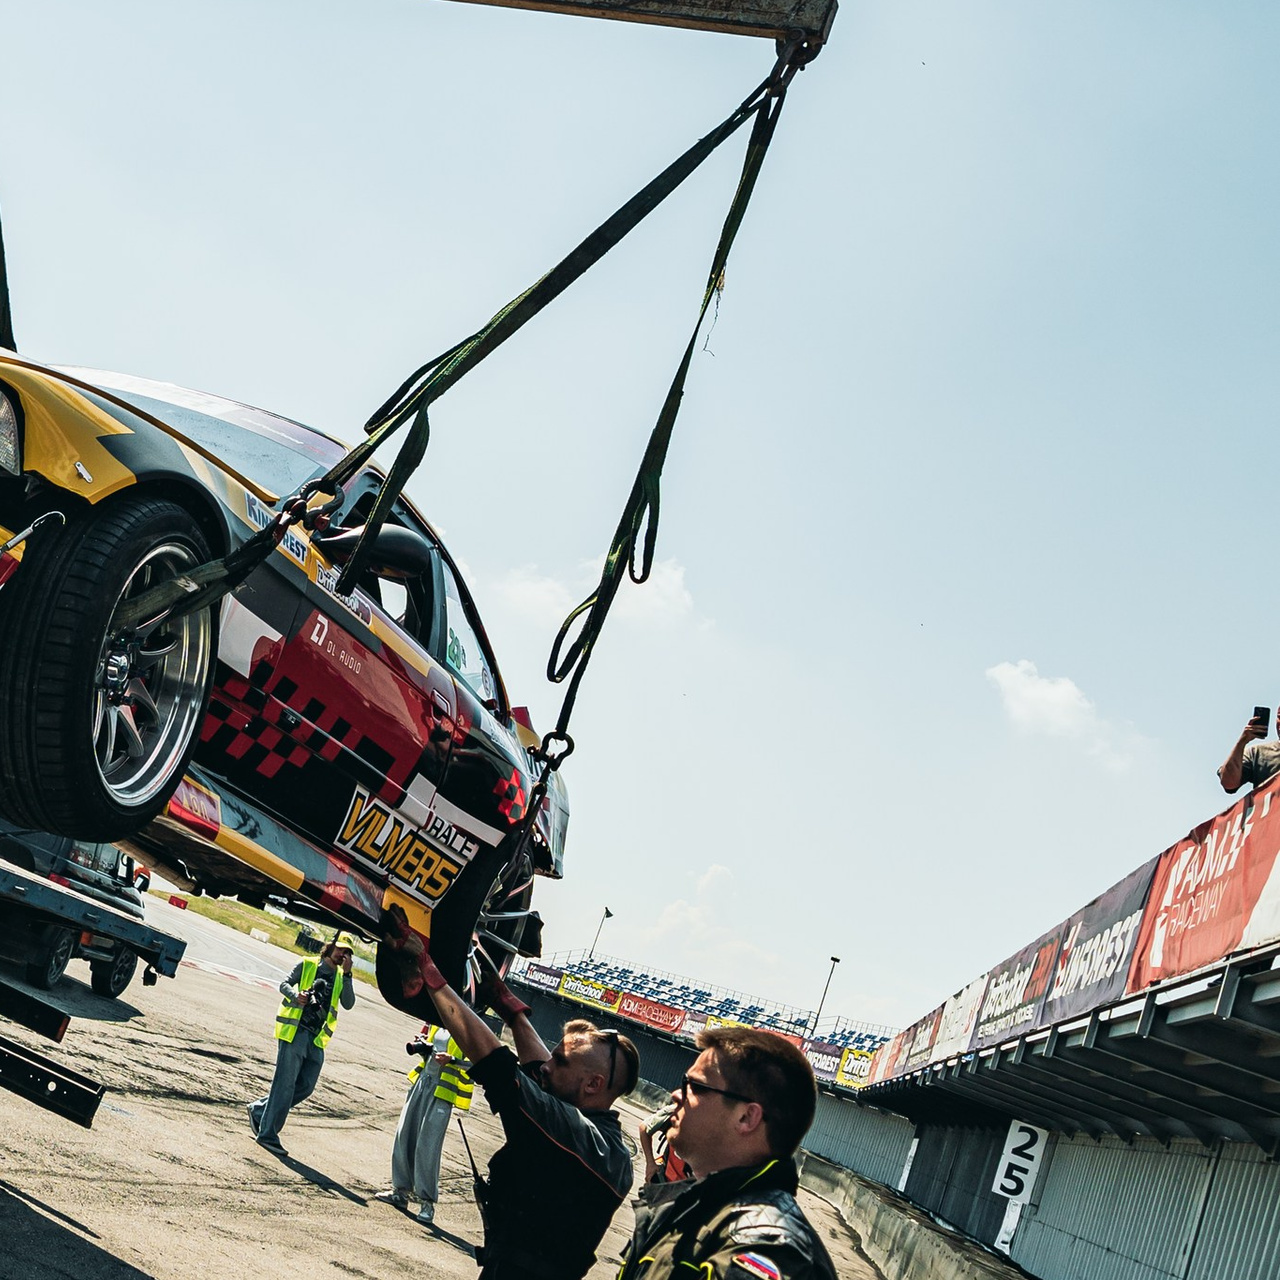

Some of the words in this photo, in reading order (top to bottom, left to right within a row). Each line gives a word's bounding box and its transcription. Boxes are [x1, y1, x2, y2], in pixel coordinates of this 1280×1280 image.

[339, 647, 362, 675] AUDIO
[339, 792, 462, 900] VILMERS
[426, 814, 477, 861] RACE
[1167, 875, 1231, 938] RACEWAY
[563, 977, 604, 1000] Driftschool
[999, 1125, 1039, 1197] 25
